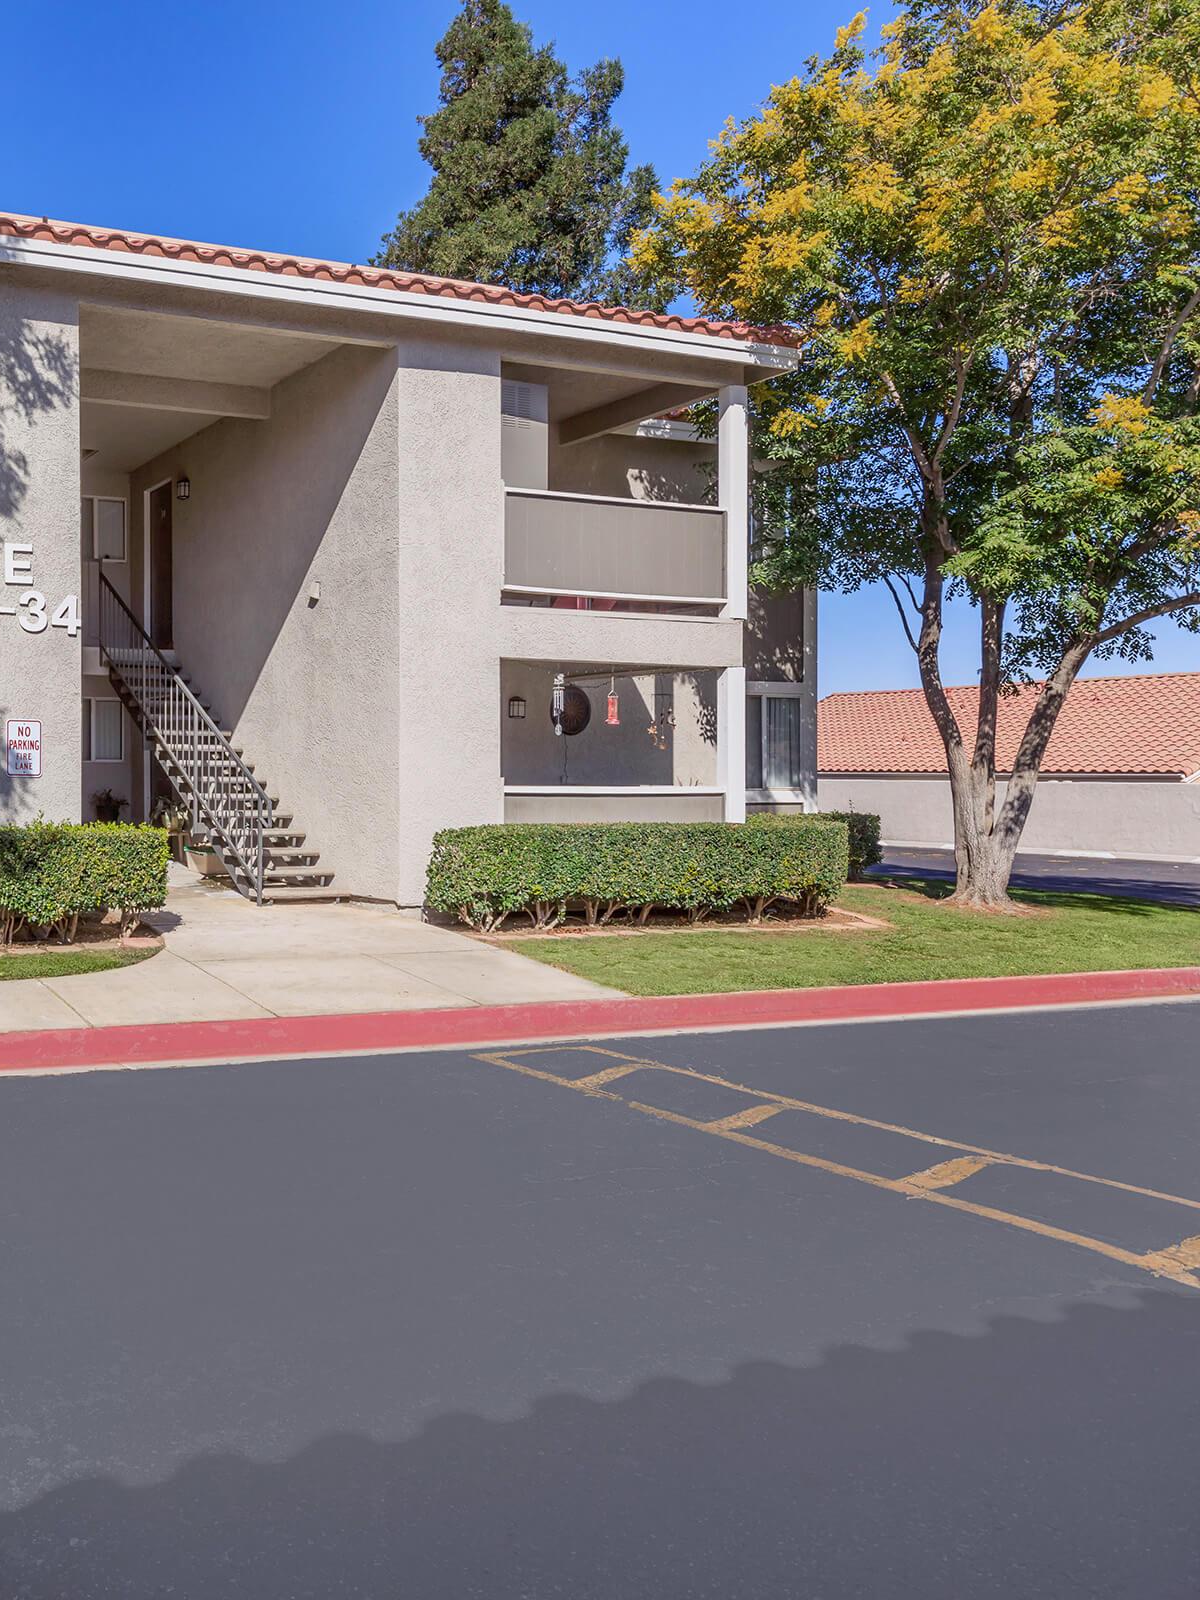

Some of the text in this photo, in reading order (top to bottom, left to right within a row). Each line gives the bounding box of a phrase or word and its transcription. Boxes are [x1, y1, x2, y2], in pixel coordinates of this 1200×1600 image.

[5, 543, 34, 586] E
[17, 726, 31, 737] NO
[9, 739, 40, 751] PARKING
[16, 752, 32, 761] FIRE
[15, 762, 33, 771] LANE
